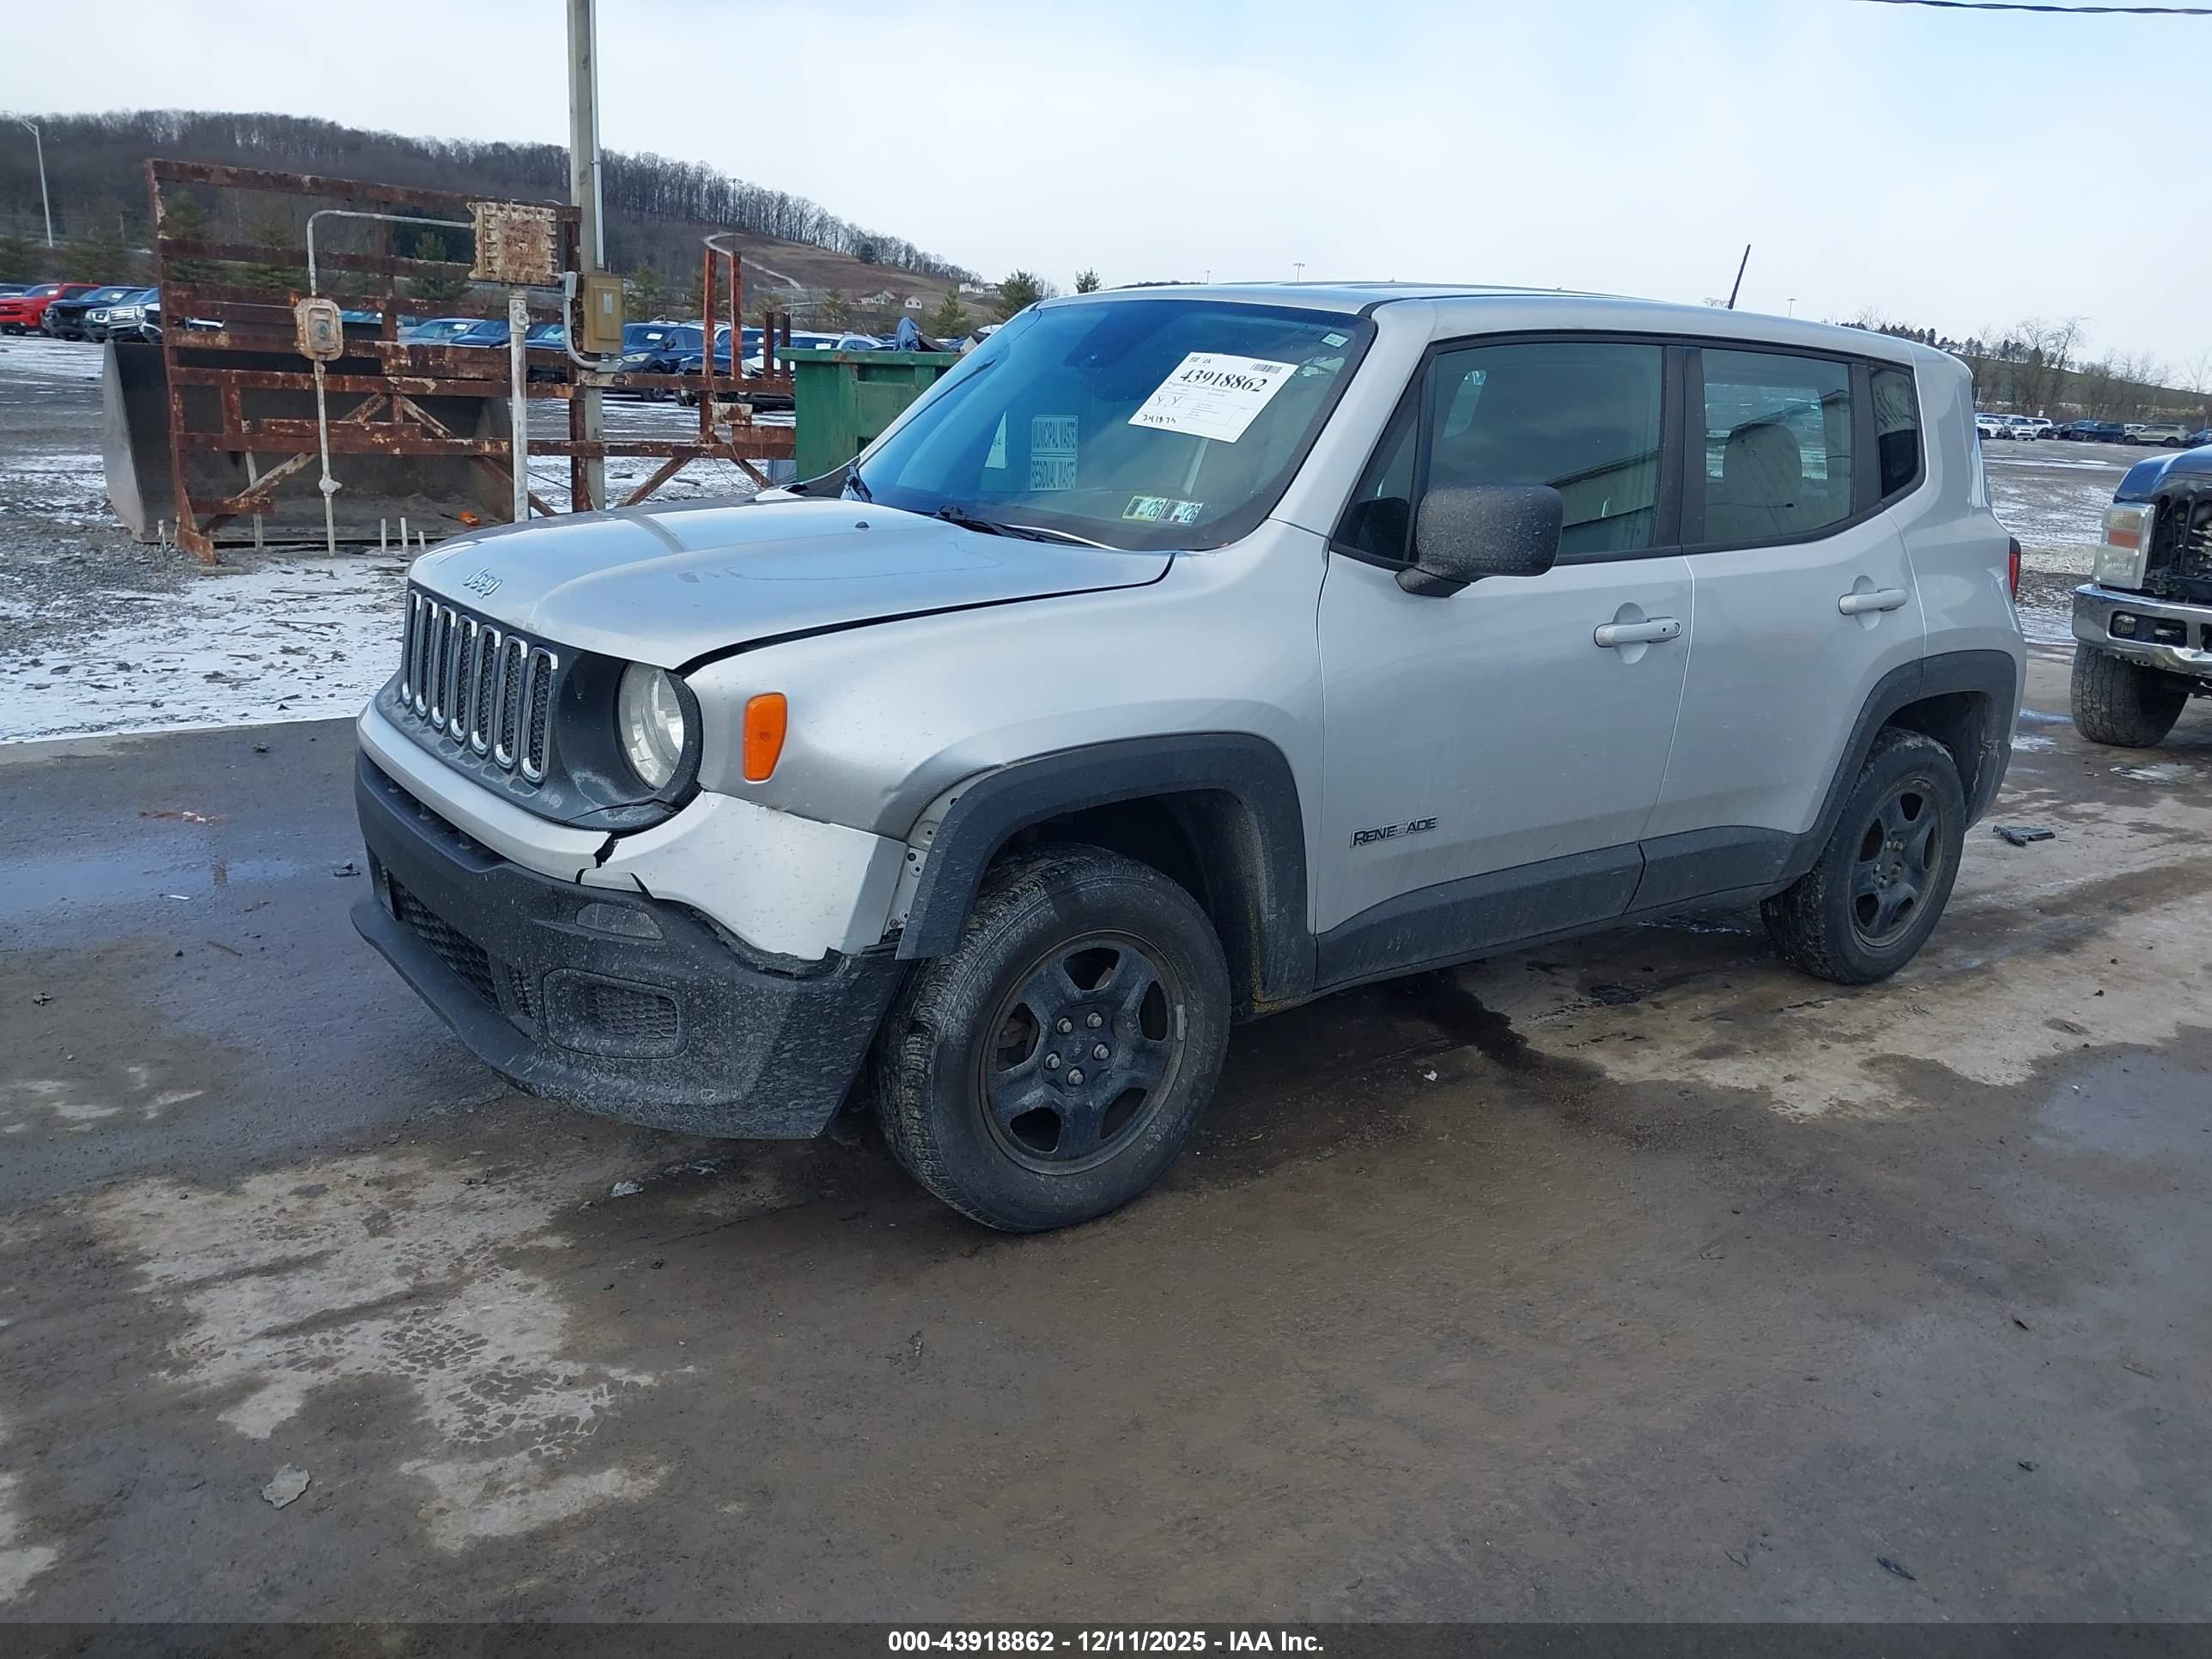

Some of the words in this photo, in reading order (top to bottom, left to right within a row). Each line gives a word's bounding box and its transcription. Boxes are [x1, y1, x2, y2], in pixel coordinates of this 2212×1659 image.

[1180, 368, 1267, 392] 43918862
[462, 567, 503, 599] Jeep
[1350, 816, 1437, 847] RENEADE
